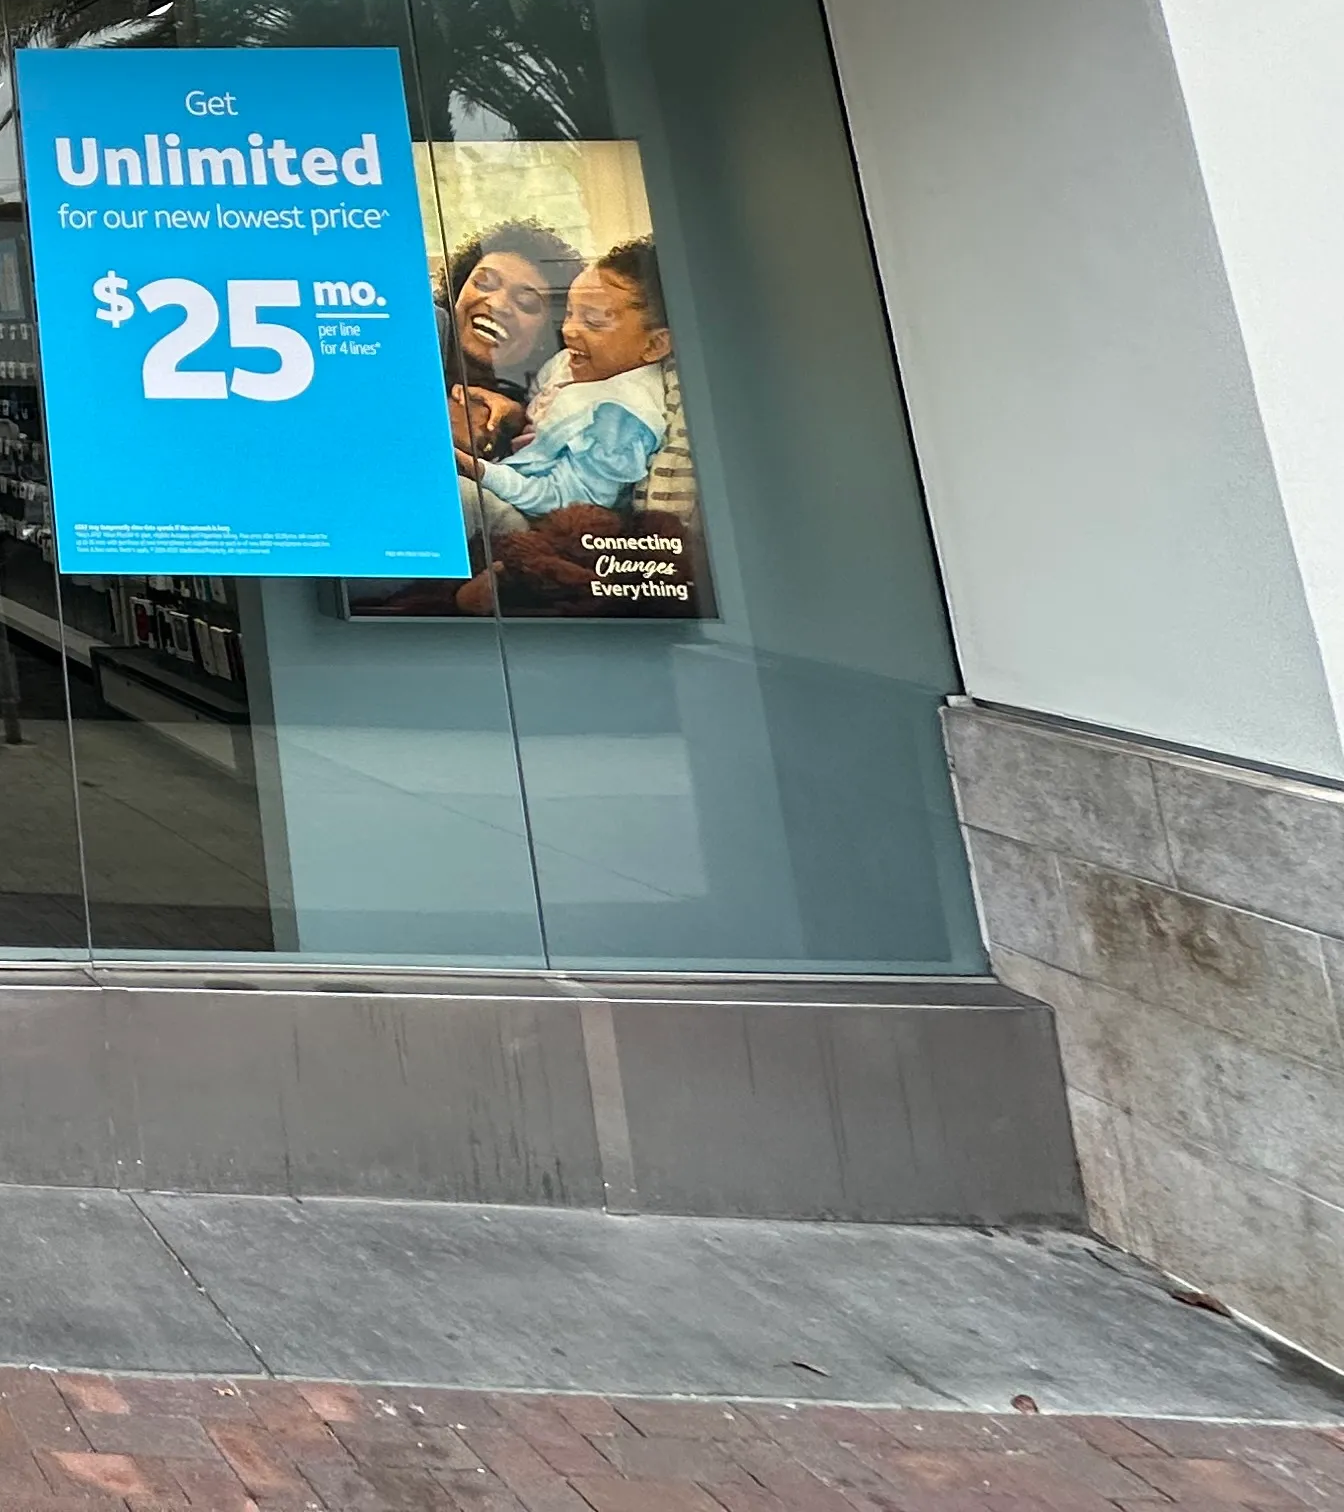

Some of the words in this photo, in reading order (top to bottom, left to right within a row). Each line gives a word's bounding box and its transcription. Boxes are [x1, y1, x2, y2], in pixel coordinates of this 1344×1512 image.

[185, 90, 239, 116] Get
[55, 133, 383, 186] Unlimited
[57, 203, 98, 229] for
[103, 210, 148, 230] our
[155, 210, 211, 230] new
[215, 204, 306, 230] lowest
[313, 281, 387, 307] mo.
[92, 270, 315, 402] $25
[318, 325, 338, 339] per
[339, 321, 361, 337] line
[320, 340, 338, 355] for
[340, 340, 348, 355] 4
[581, 533, 683, 554] Connecting
[595, 554, 678, 578] Changes
